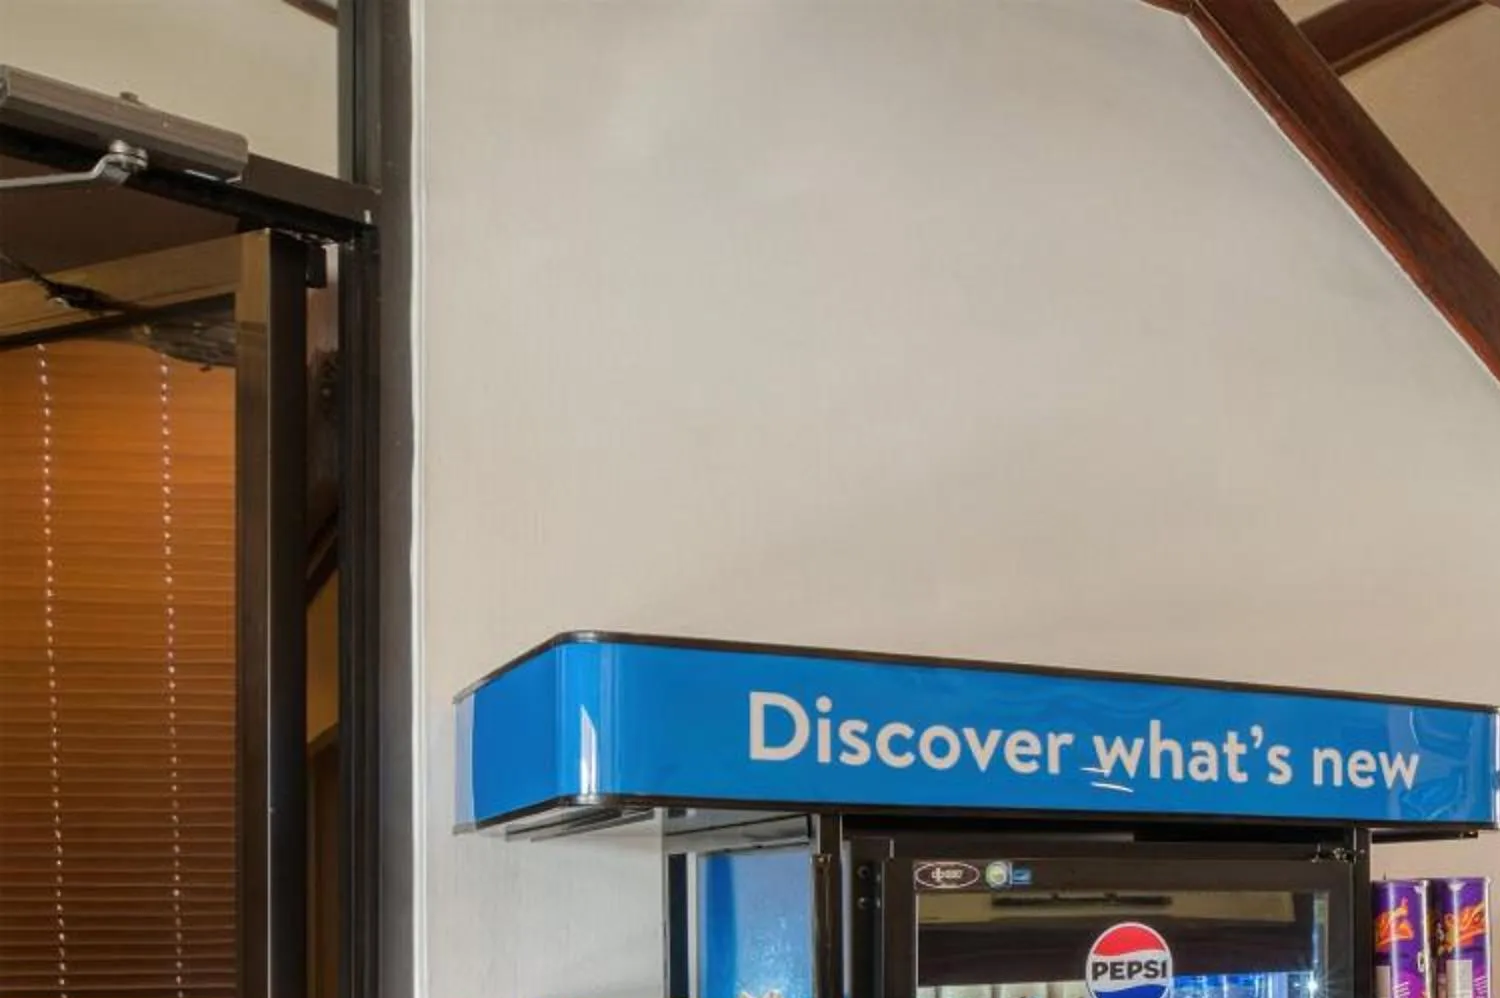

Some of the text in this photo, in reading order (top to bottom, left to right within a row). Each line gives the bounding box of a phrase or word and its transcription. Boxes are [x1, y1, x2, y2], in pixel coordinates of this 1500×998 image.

[749, 690, 1420, 790] Discover what's new
[1091, 959, 1167, 981] PEPSI
